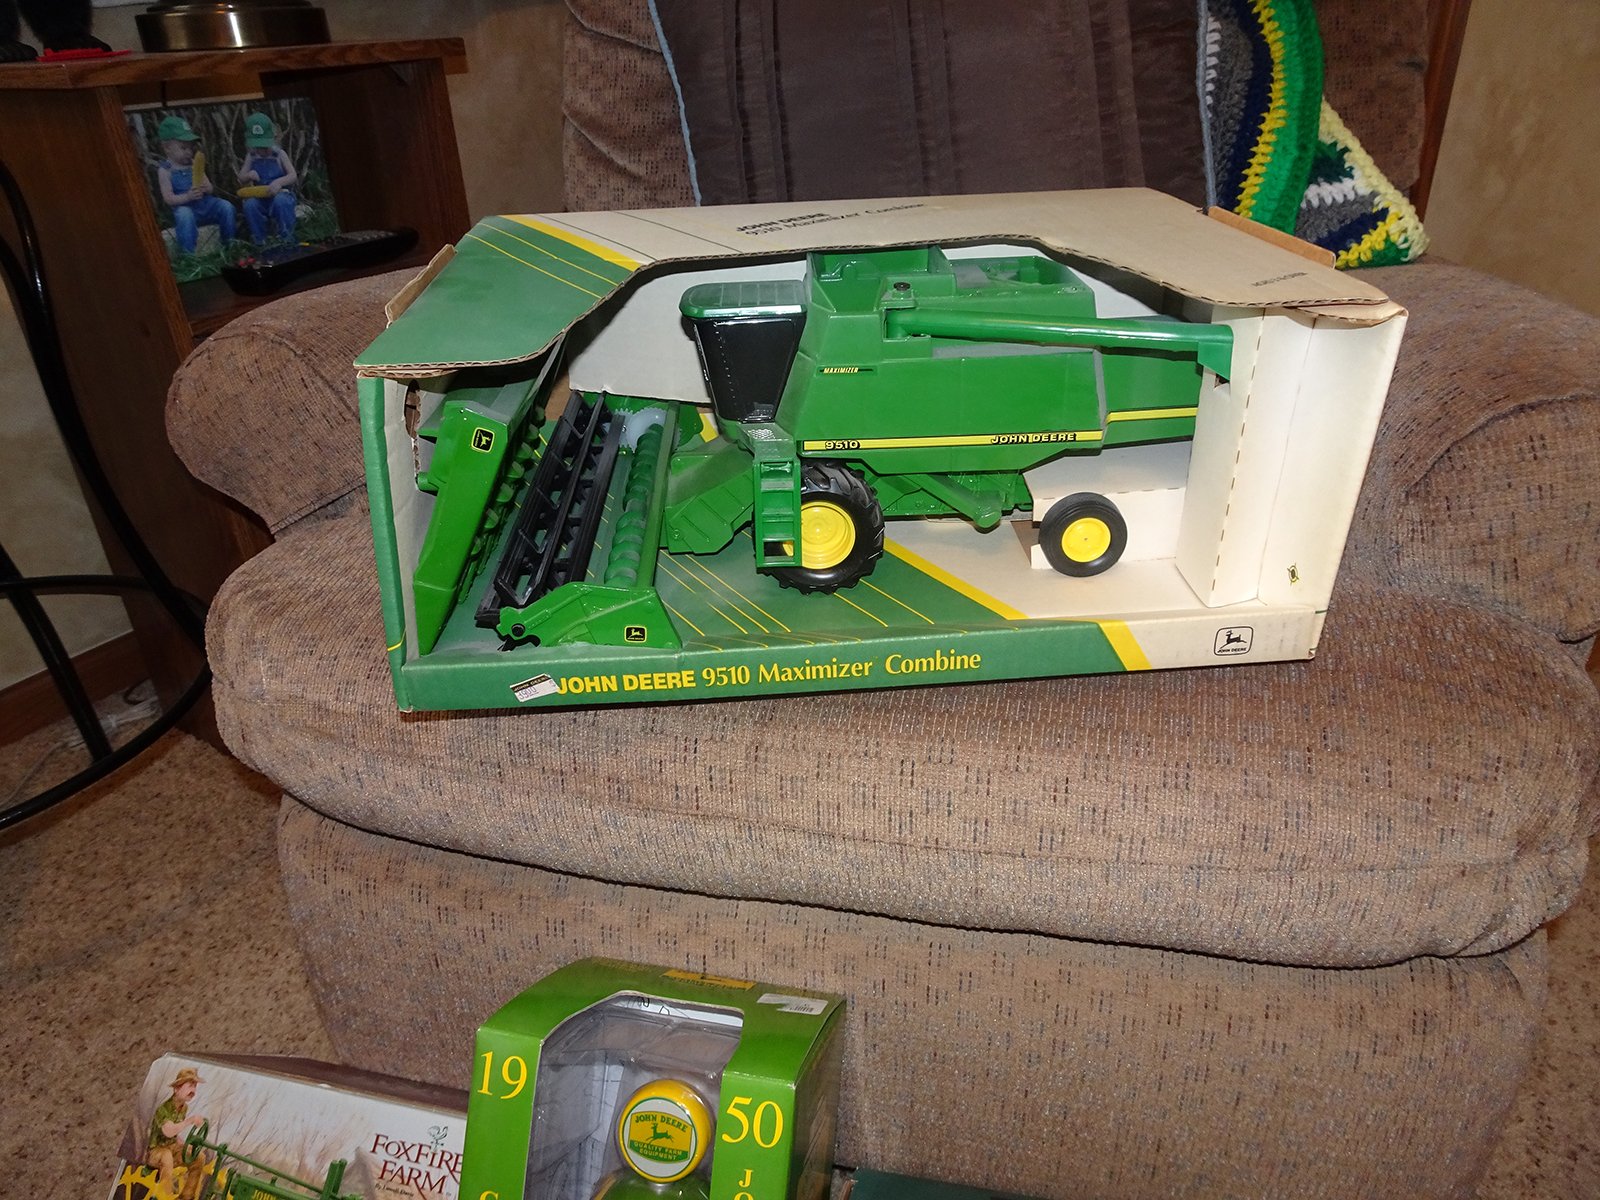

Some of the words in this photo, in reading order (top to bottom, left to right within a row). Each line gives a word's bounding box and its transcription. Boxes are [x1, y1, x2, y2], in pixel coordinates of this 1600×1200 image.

[736, 220, 779, 232] JOHN
[778, 213, 830, 224] DEERE
[825, 440, 860, 450] 9510
[991, 433, 1029, 445] JOHN
[1031, 431, 1077, 443] DEERE
[558, 677, 618, 695] JOHN
[622, 670, 697, 691] DEERE
[702, 666, 750, 687] 9510
[759, 657, 873, 683] Maximizer
[885, 649, 981, 674] Combine
[477, 1051, 528, 1099] 19
[635, 1114, 657, 1123] JOHN
[660, 1115, 688, 1133] DEERE
[721, 1096, 784, 1148] 50
[633, 1141, 662, 1153] QUALITY
[664, 1148, 683, 1156] FARM
[639, 1149, 677, 1160] EQUIPMENT
[378, 1159, 448, 1200] FARM
